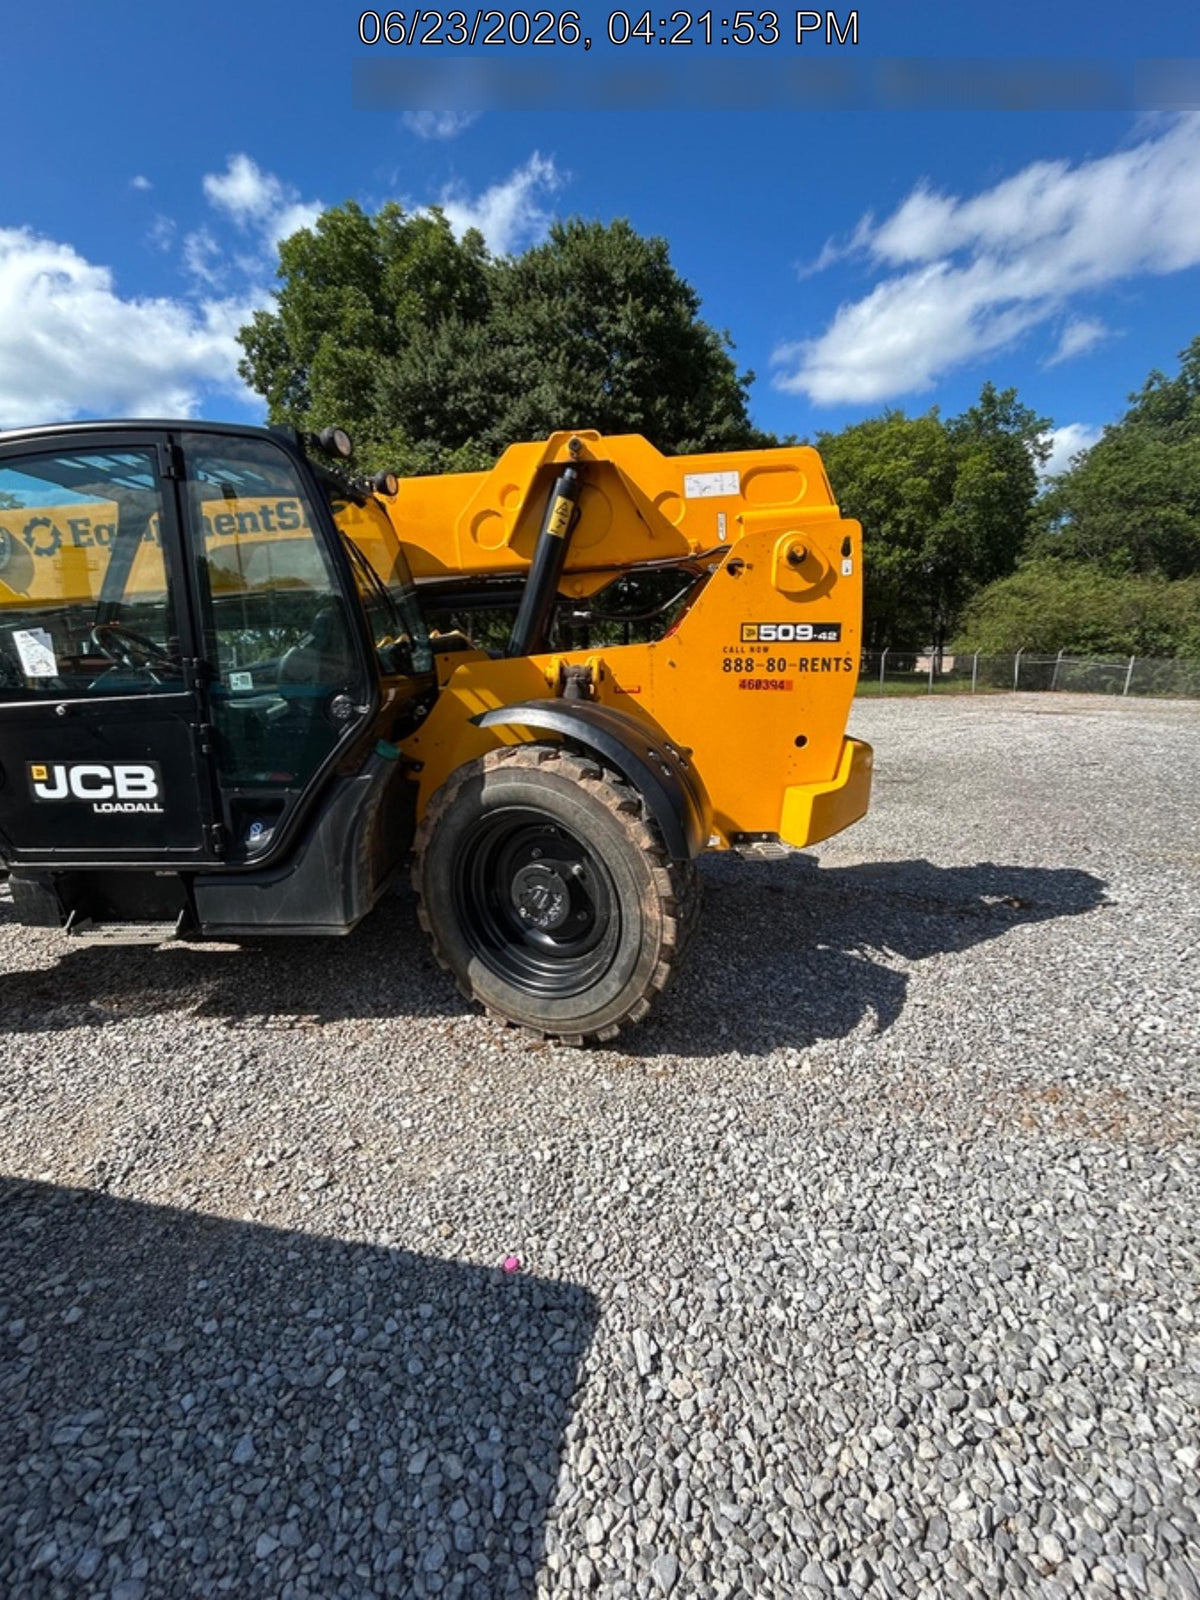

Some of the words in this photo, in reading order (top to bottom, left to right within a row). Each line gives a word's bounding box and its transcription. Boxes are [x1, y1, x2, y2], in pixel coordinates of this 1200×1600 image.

[723, 657, 853, 672] 888-80-RENTS
[33, 765, 158, 799] JCB
[93, 803, 164, 813] LOADALL
